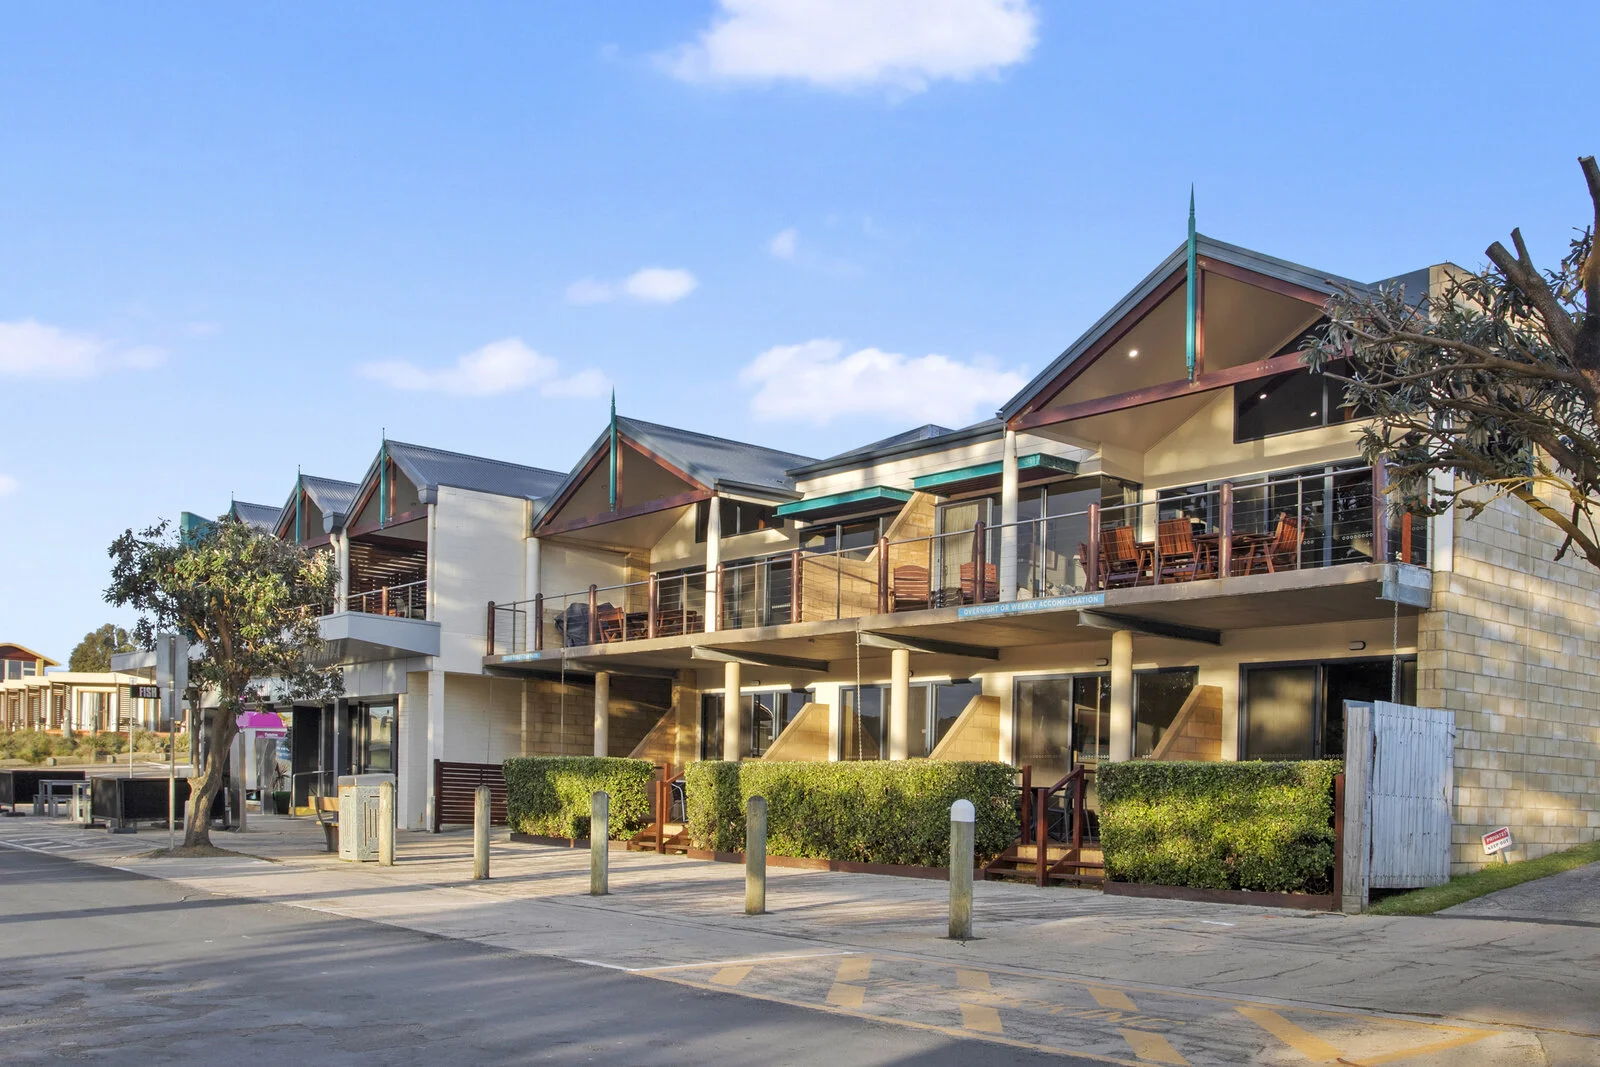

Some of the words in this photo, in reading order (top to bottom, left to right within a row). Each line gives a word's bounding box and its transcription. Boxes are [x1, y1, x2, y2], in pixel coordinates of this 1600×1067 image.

[963, 605, 998, 615] OVERNIGHT
[1001, 603, 1009, 611] OR
[1011, 602, 1036, 610] WEEKLY
[1039, 596, 1099, 607] ACCOMMODATION
[139, 686, 157, 698] FISH
[1487, 842, 1499, 850] KEEP
[1500, 838, 1509, 846] OUT
